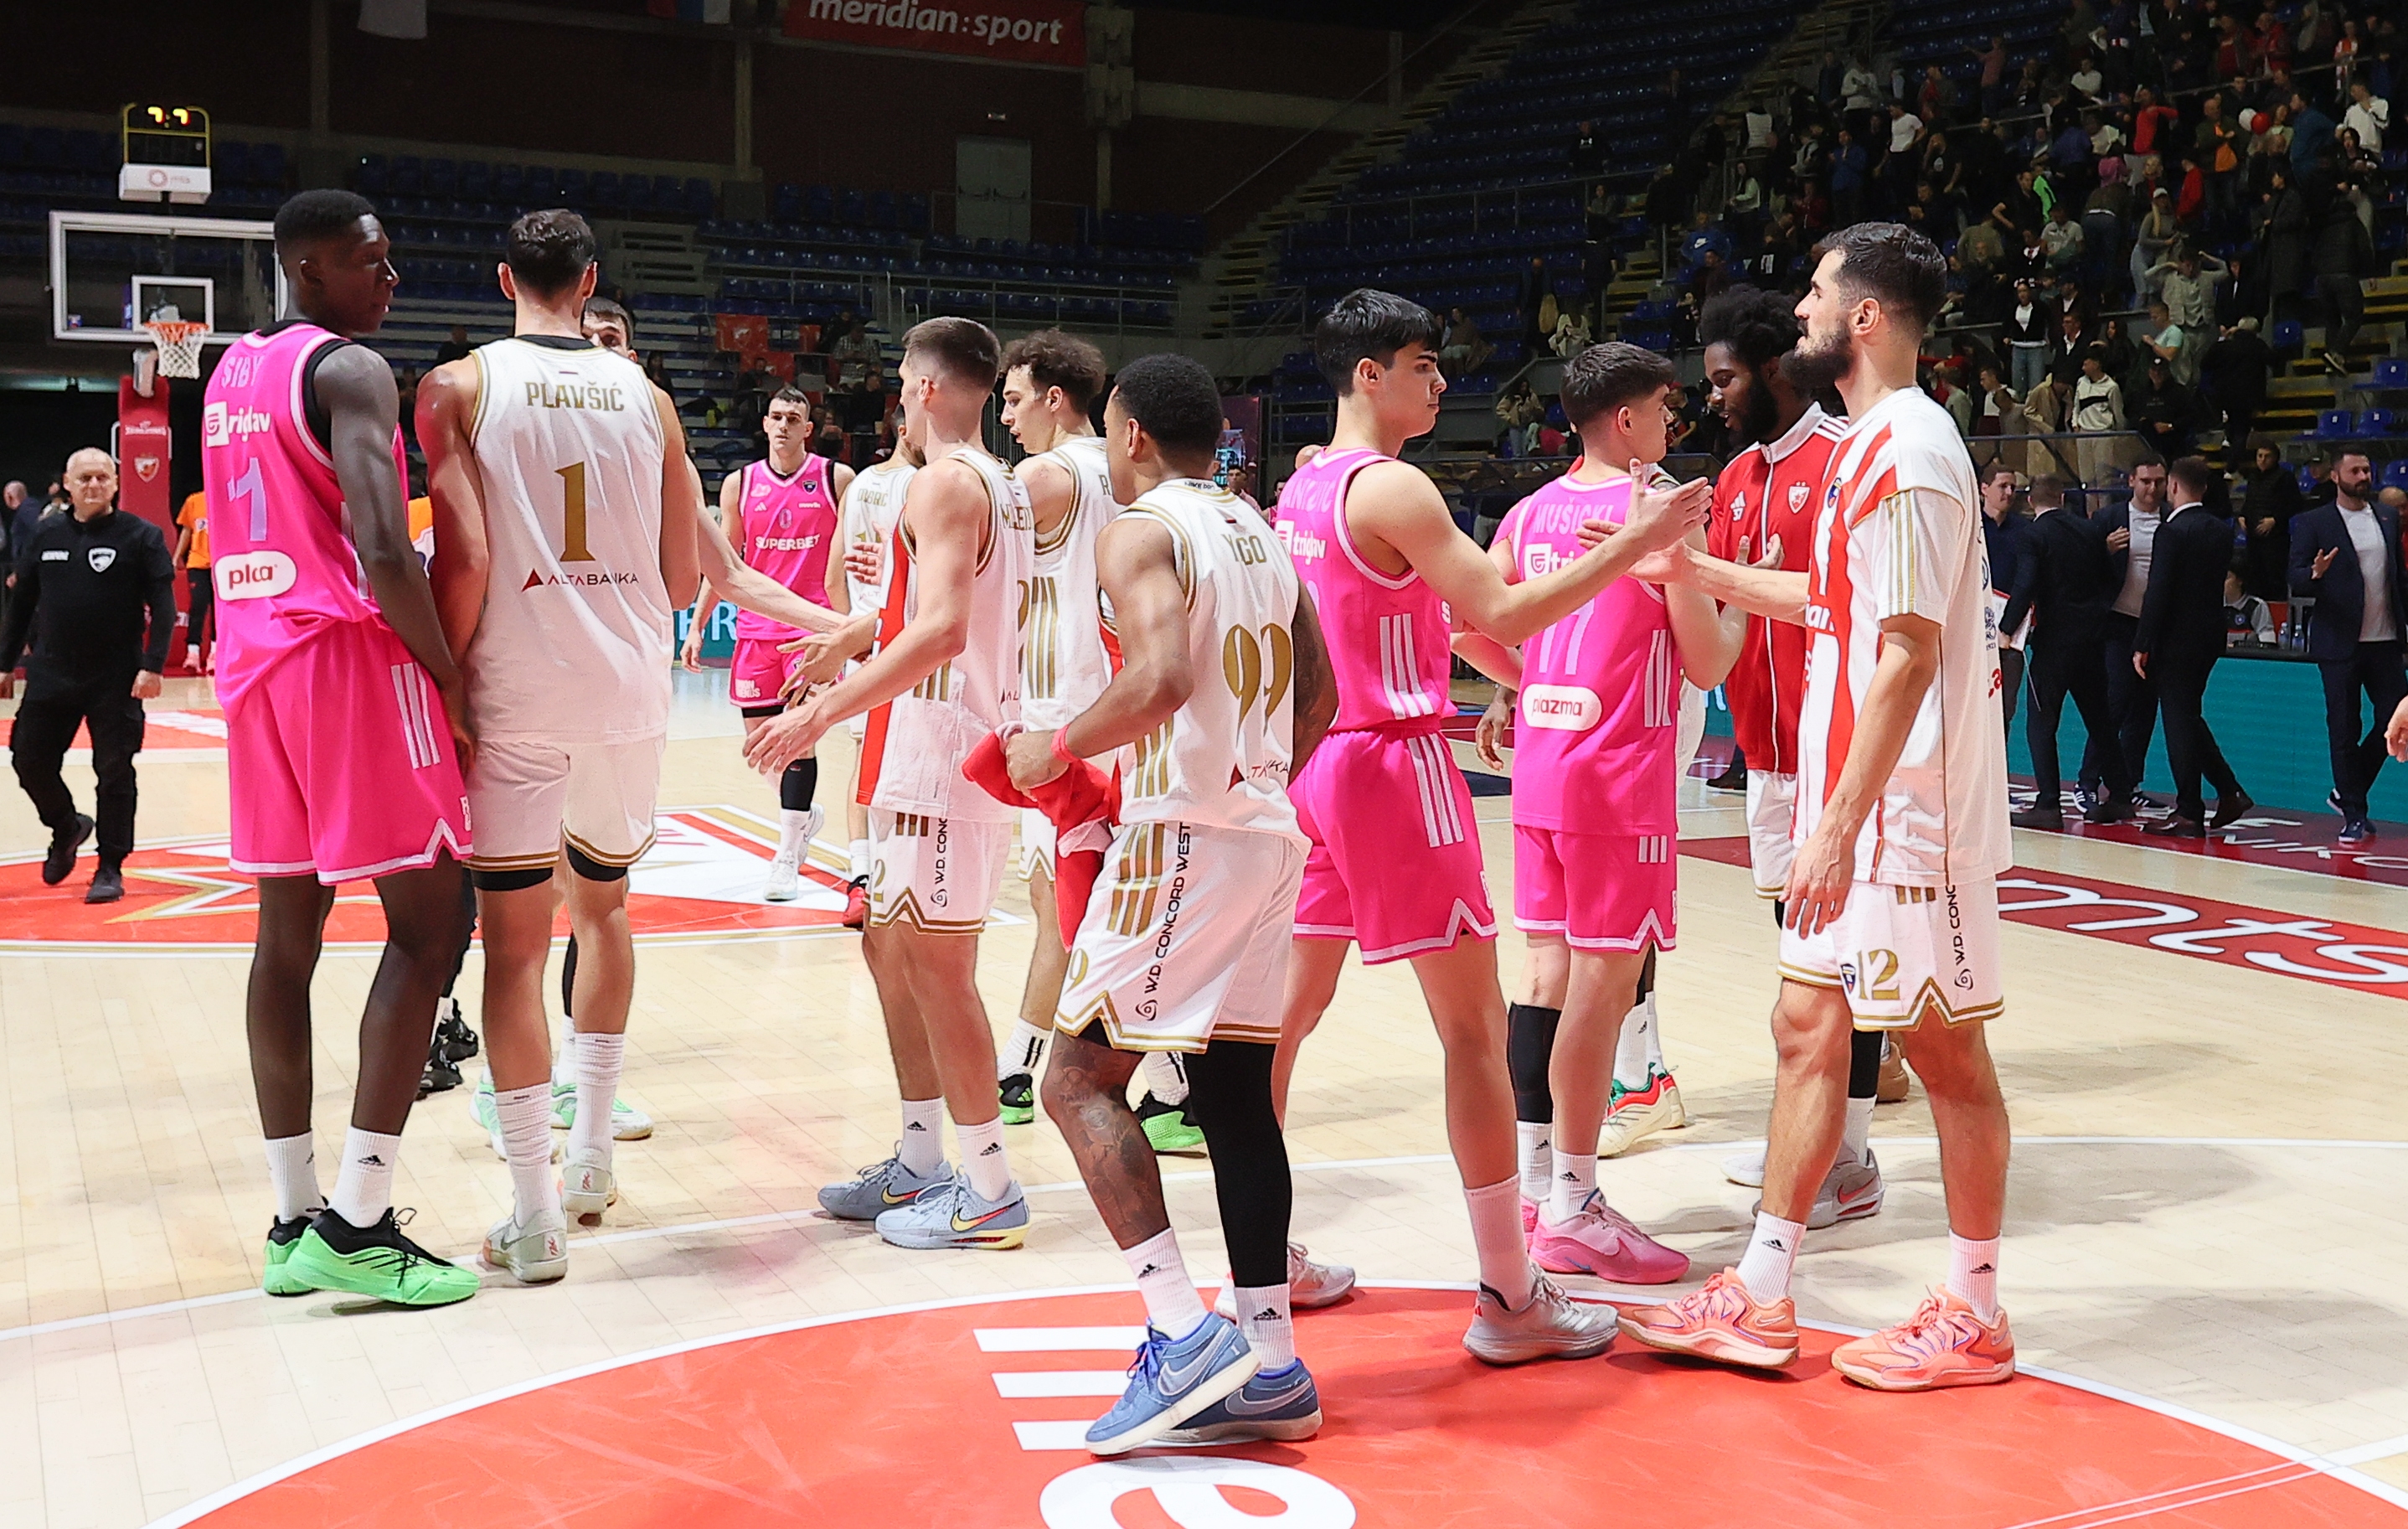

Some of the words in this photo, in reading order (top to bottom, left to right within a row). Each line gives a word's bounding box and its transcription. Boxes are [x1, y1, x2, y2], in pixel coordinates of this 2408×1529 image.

[524, 380, 626, 412] PLAVŠIĆ
[554, 461, 596, 562] 1
[755, 533, 821, 551] SUPERBET
[1223, 622, 1292, 749] 99
[1533, 695, 1583, 717] plazma
[935, 856, 946, 885] W.D.
[1144, 962, 1163, 994] W.D.
[1155, 876, 1185, 958] CONCORD
[1176, 821, 1192, 872] WEST
[1952, 932, 1966, 966] W.D.
[1857, 948, 1900, 1001] 12
